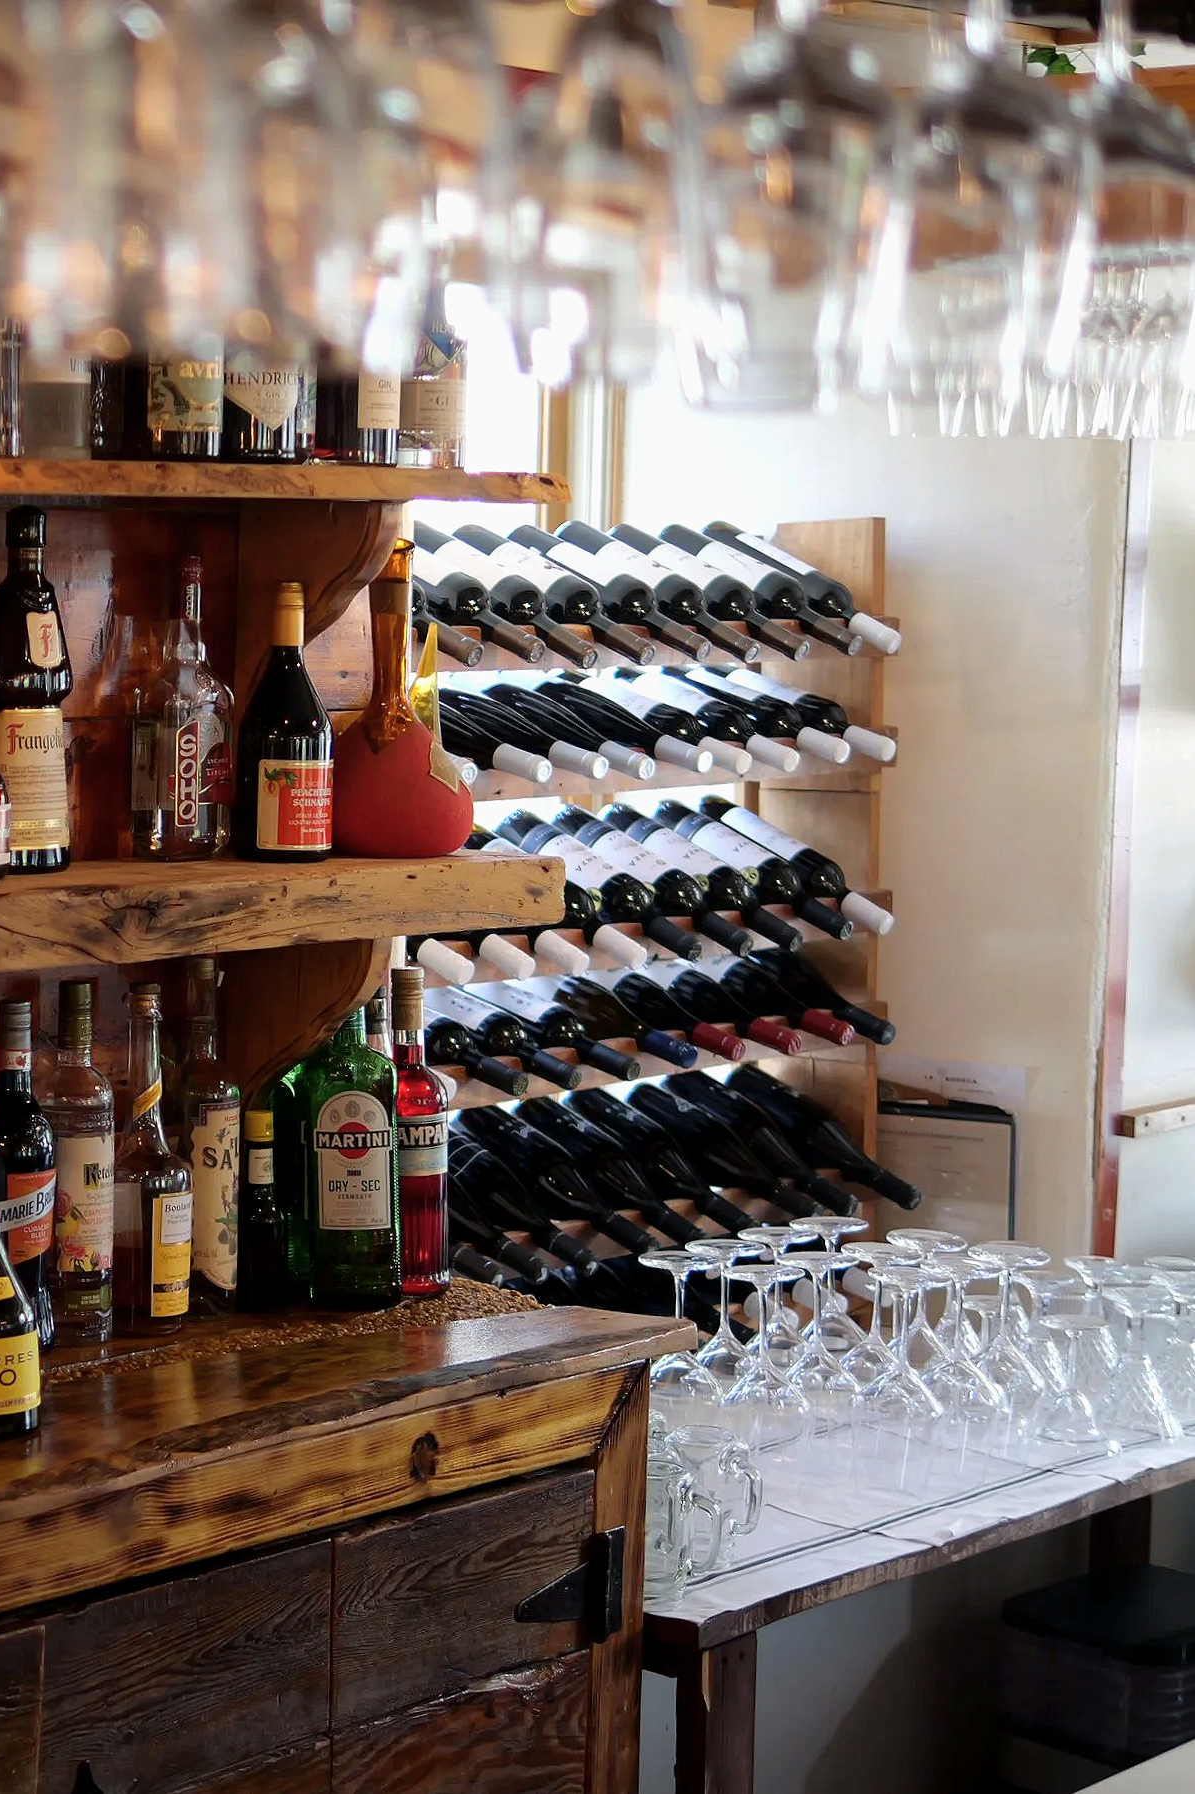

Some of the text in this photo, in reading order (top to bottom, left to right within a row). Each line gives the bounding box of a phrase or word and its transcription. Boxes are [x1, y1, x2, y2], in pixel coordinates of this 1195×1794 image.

[179, 733, 196, 820] SOHO
[317, 1131, 389, 1149] MARTINI
[399, 1123, 448, 1147] AMPA
[328, 1180, 348, 1193] DRY
[361, 1179, 381, 1192] SEC
[0, 1200, 35, 1224] MARIE
